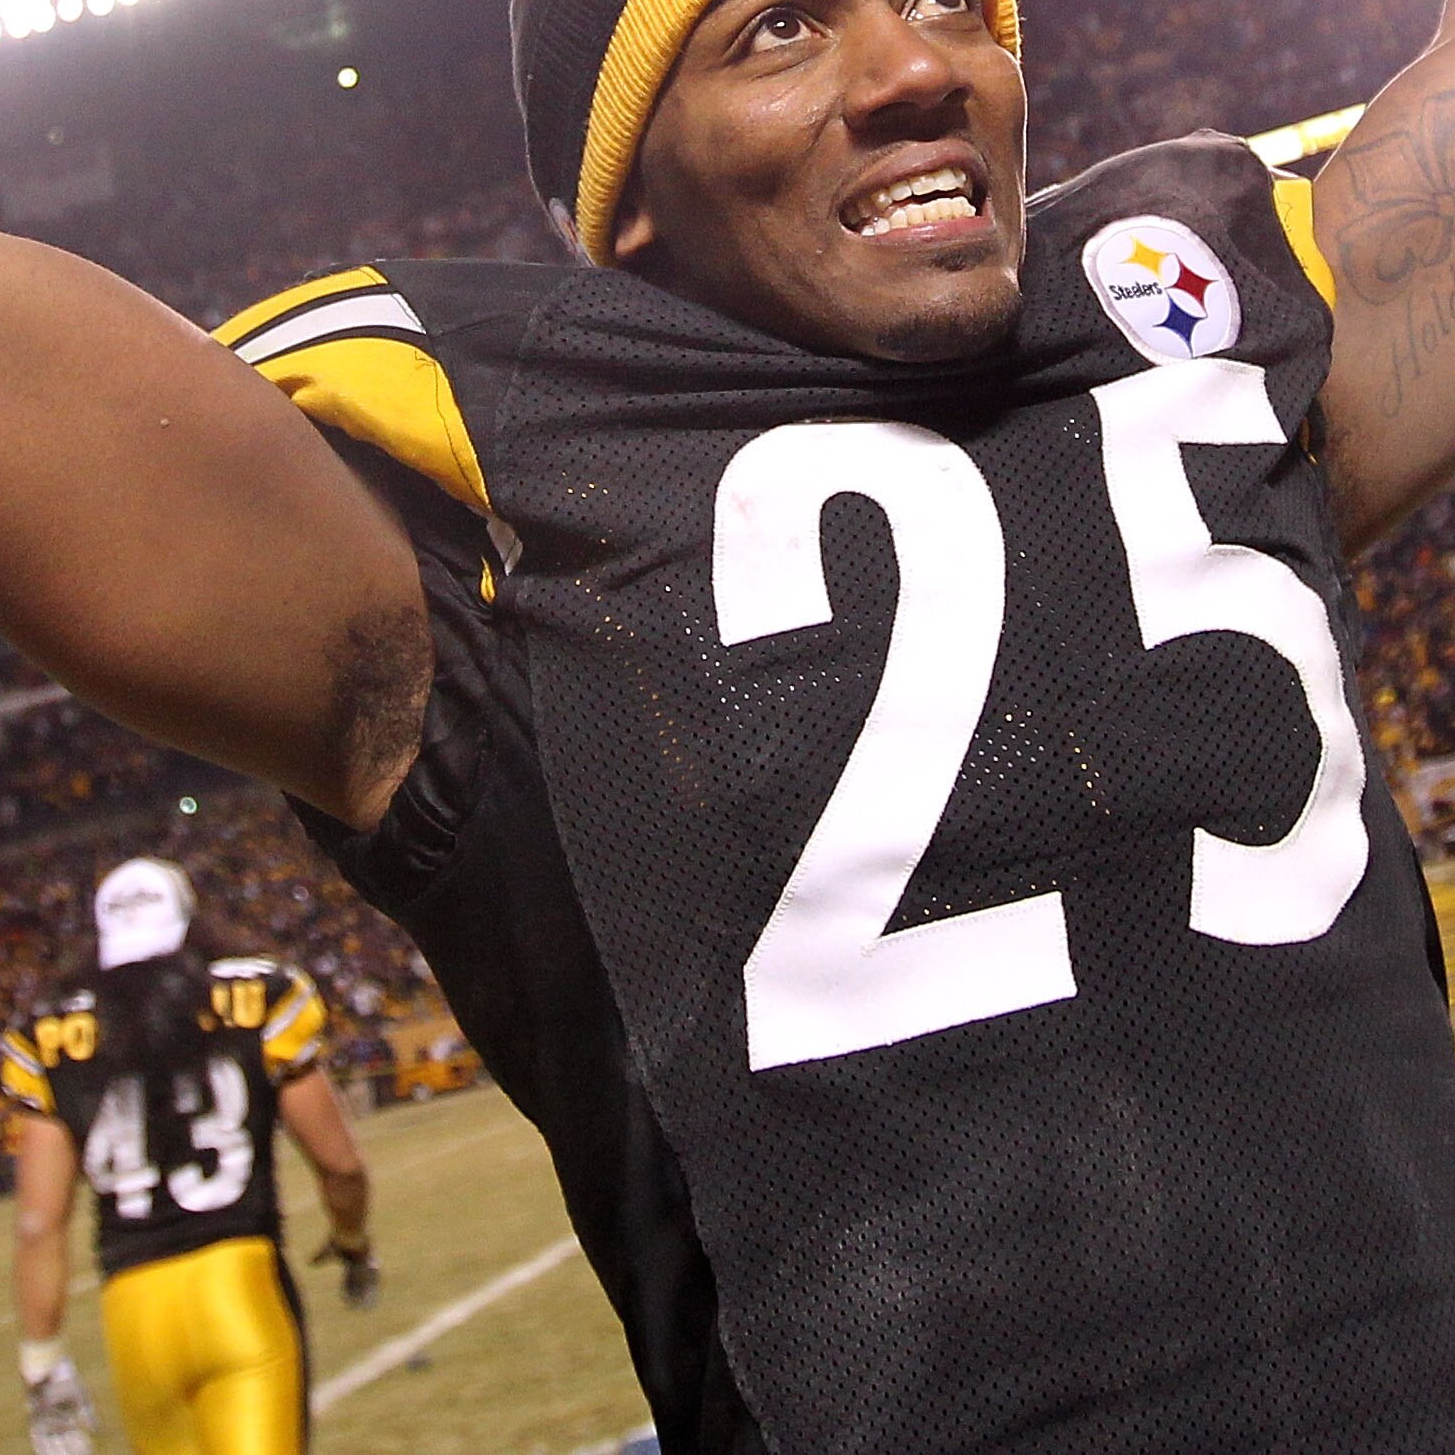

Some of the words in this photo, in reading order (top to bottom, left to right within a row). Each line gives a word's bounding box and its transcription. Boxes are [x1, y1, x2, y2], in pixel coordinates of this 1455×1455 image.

[1108, 281, 1164, 301] Steelers
[711, 357, 1371, 1073] 25
[82, 1057, 255, 1220] 43
